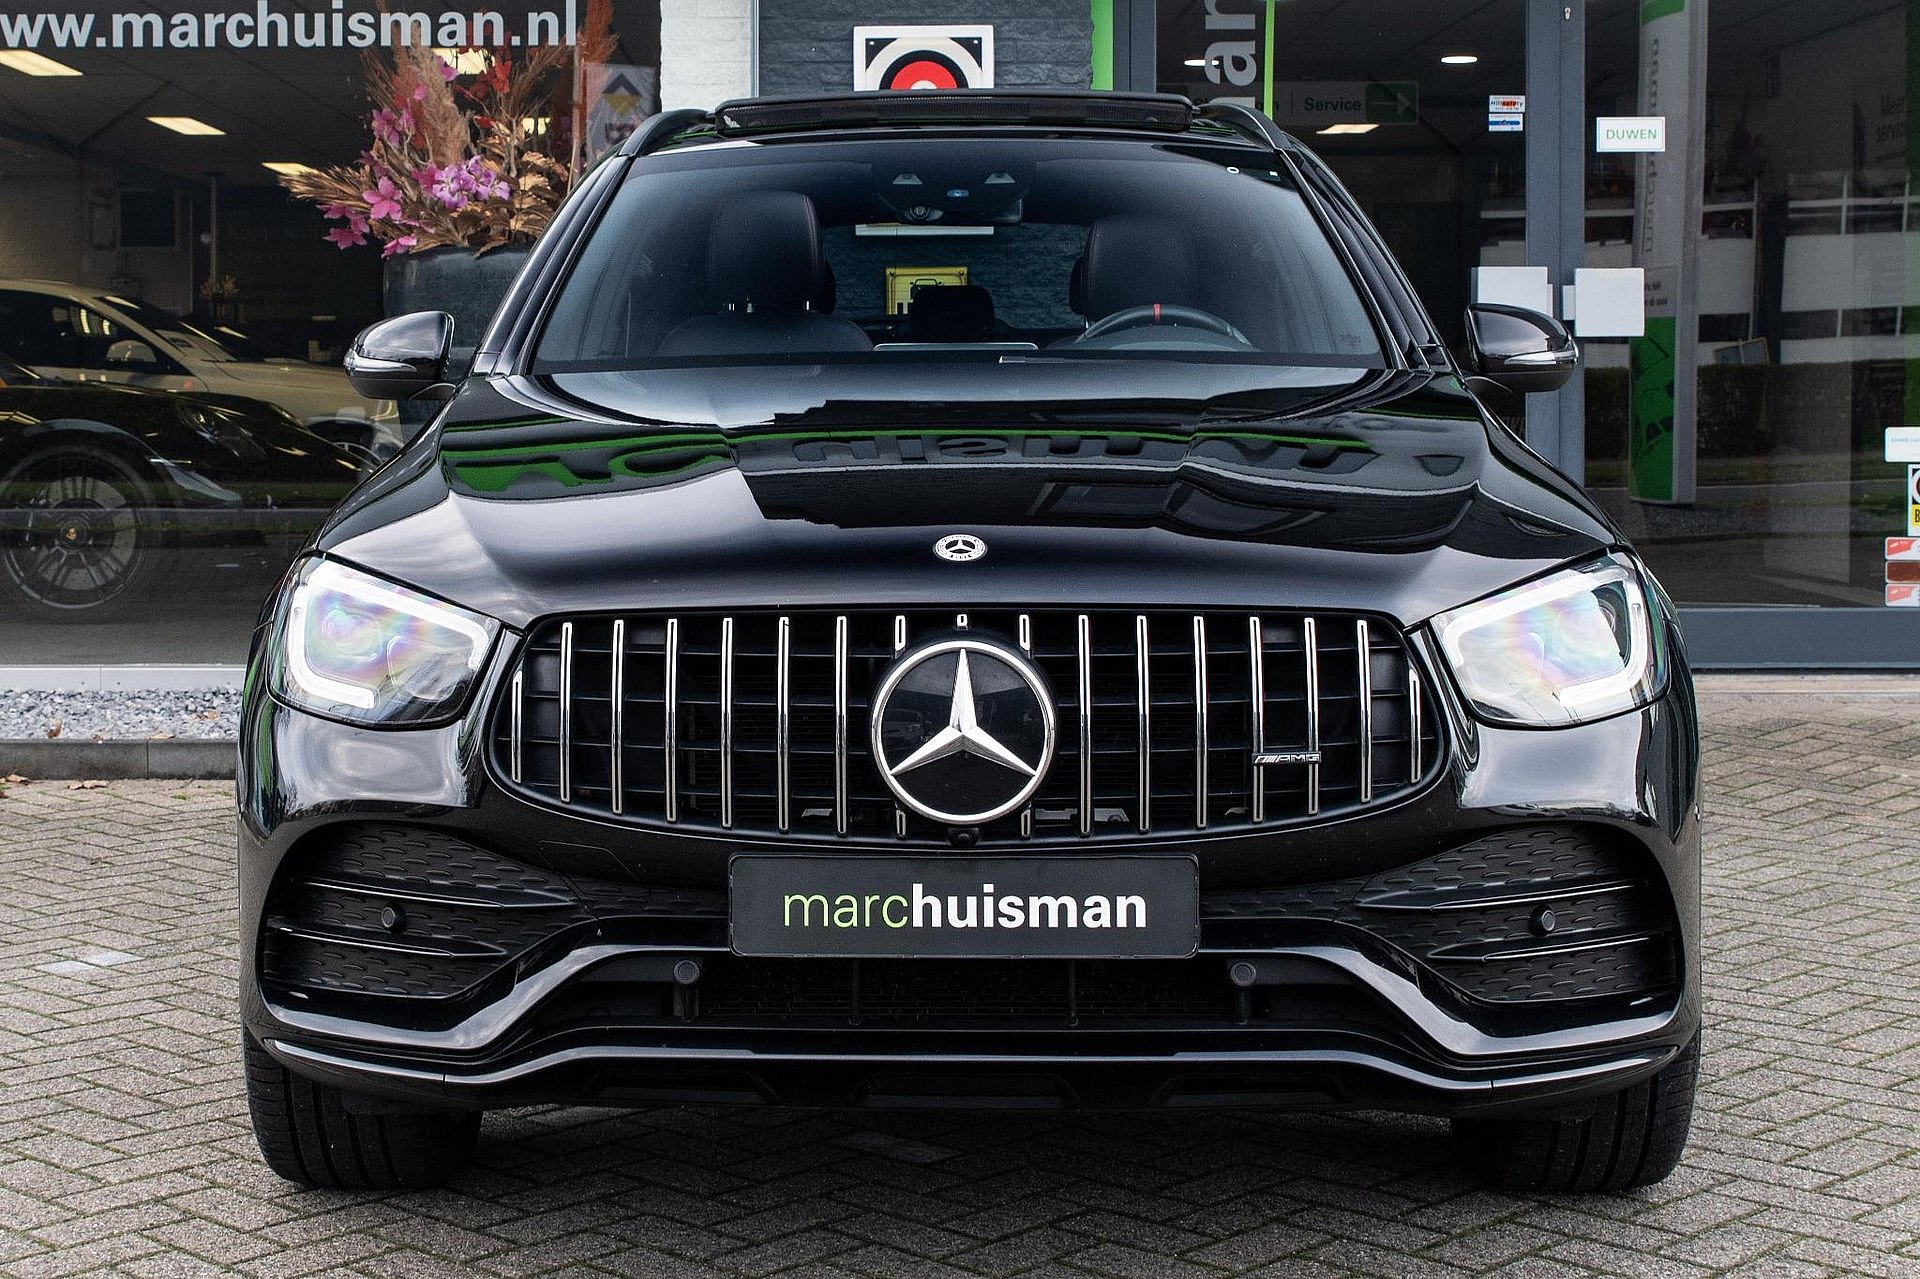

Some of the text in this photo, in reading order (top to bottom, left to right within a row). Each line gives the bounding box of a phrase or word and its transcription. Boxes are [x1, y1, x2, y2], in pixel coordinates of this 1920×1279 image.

[1304, 97, 1361, 112] Service
[1606, 129, 1657, 139] DUWEN
[1274, 753, 1320, 763] AMG
[783, 883, 1147, 928] marchuisman
